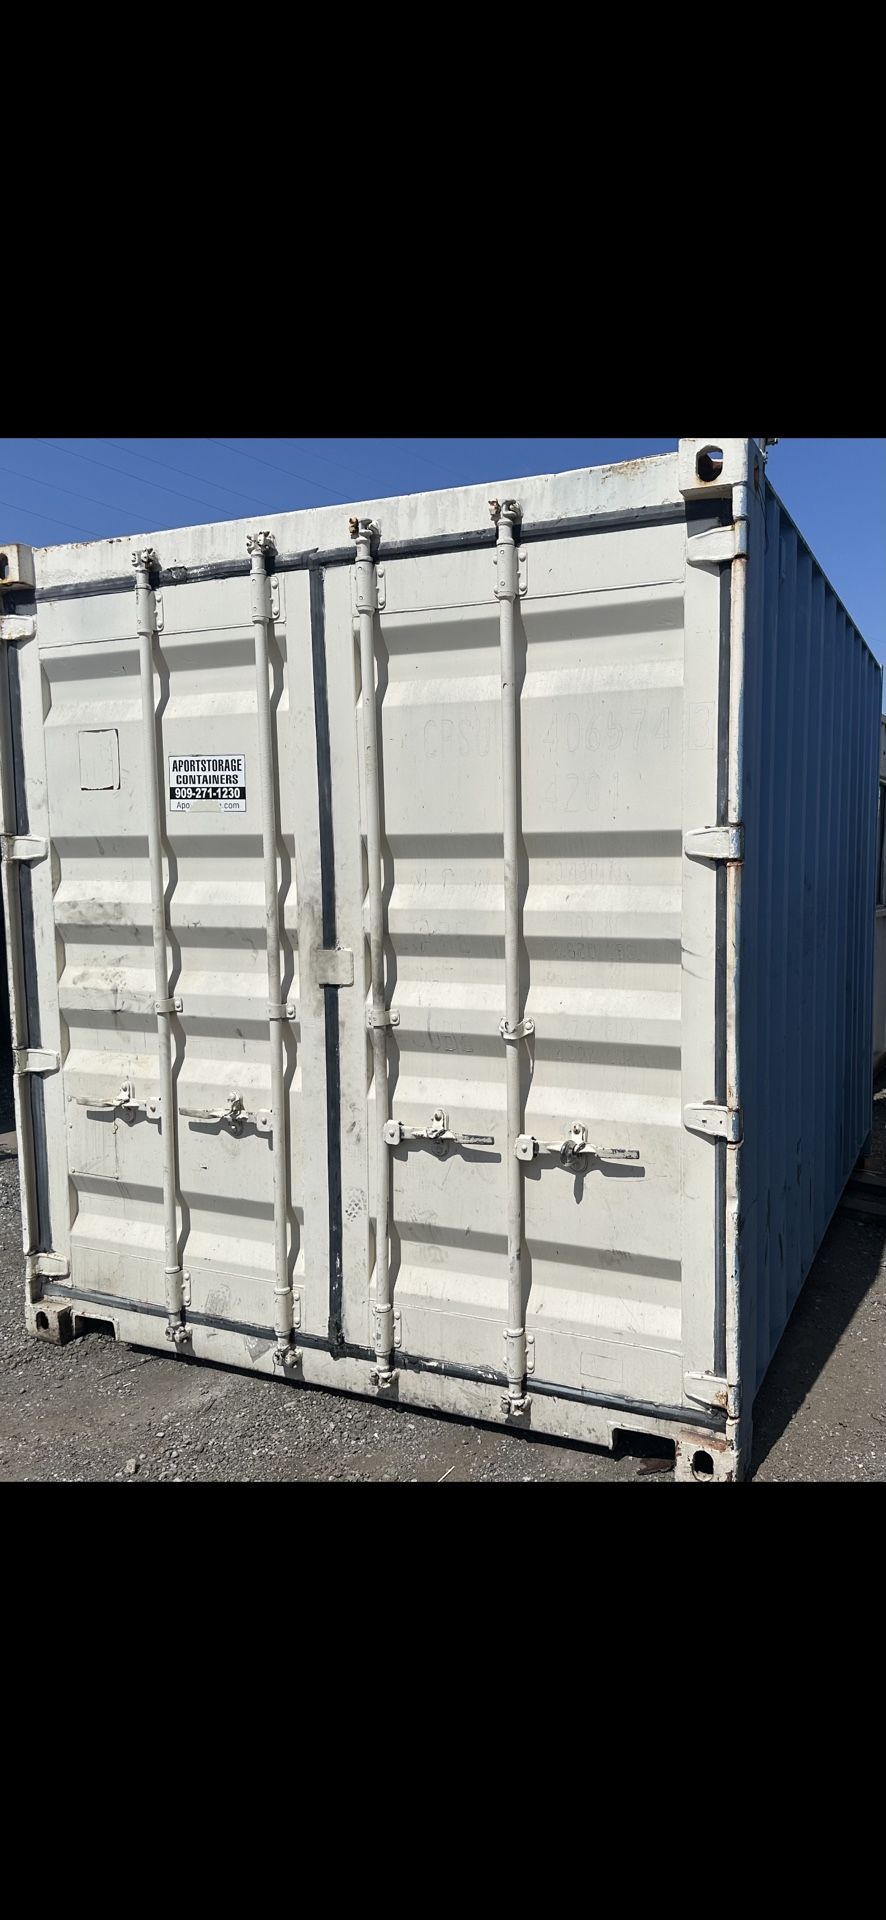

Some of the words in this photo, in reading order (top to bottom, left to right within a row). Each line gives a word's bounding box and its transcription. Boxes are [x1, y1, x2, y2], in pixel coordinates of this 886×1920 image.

[172, 758, 243, 773] APORTSTORAGE
[176, 774, 239, 785] CONTAINERS
[174, 787, 241, 799] 909-271-1230
